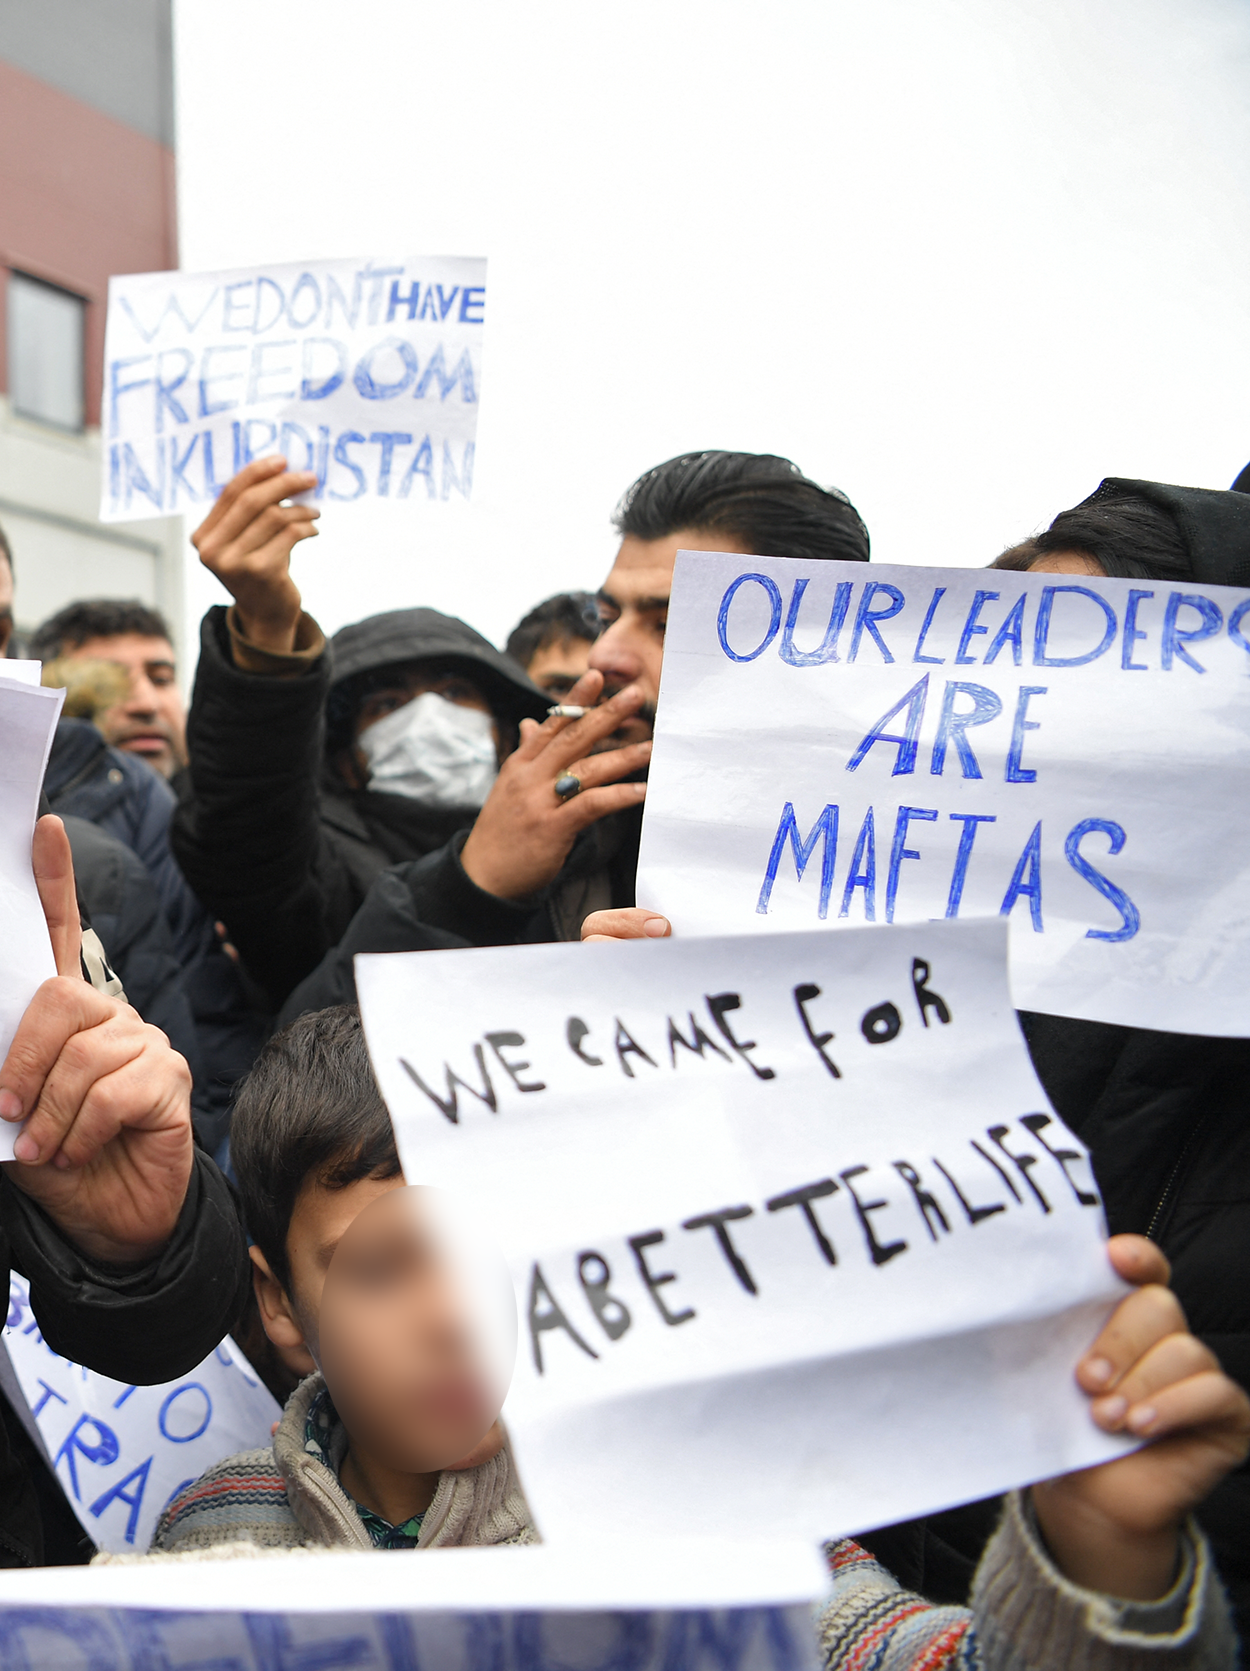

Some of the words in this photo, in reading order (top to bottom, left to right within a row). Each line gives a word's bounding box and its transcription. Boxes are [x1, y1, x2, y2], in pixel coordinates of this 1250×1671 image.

[110, 337, 478, 438] FREEDOM
[845, 671, 1048, 783] ARE
[400, 1031, 546, 1124] WE
[567, 992, 776, 1080] CAME
[794, 957, 952, 1079] FOR
[31, 1378, 200, 1545] RA
